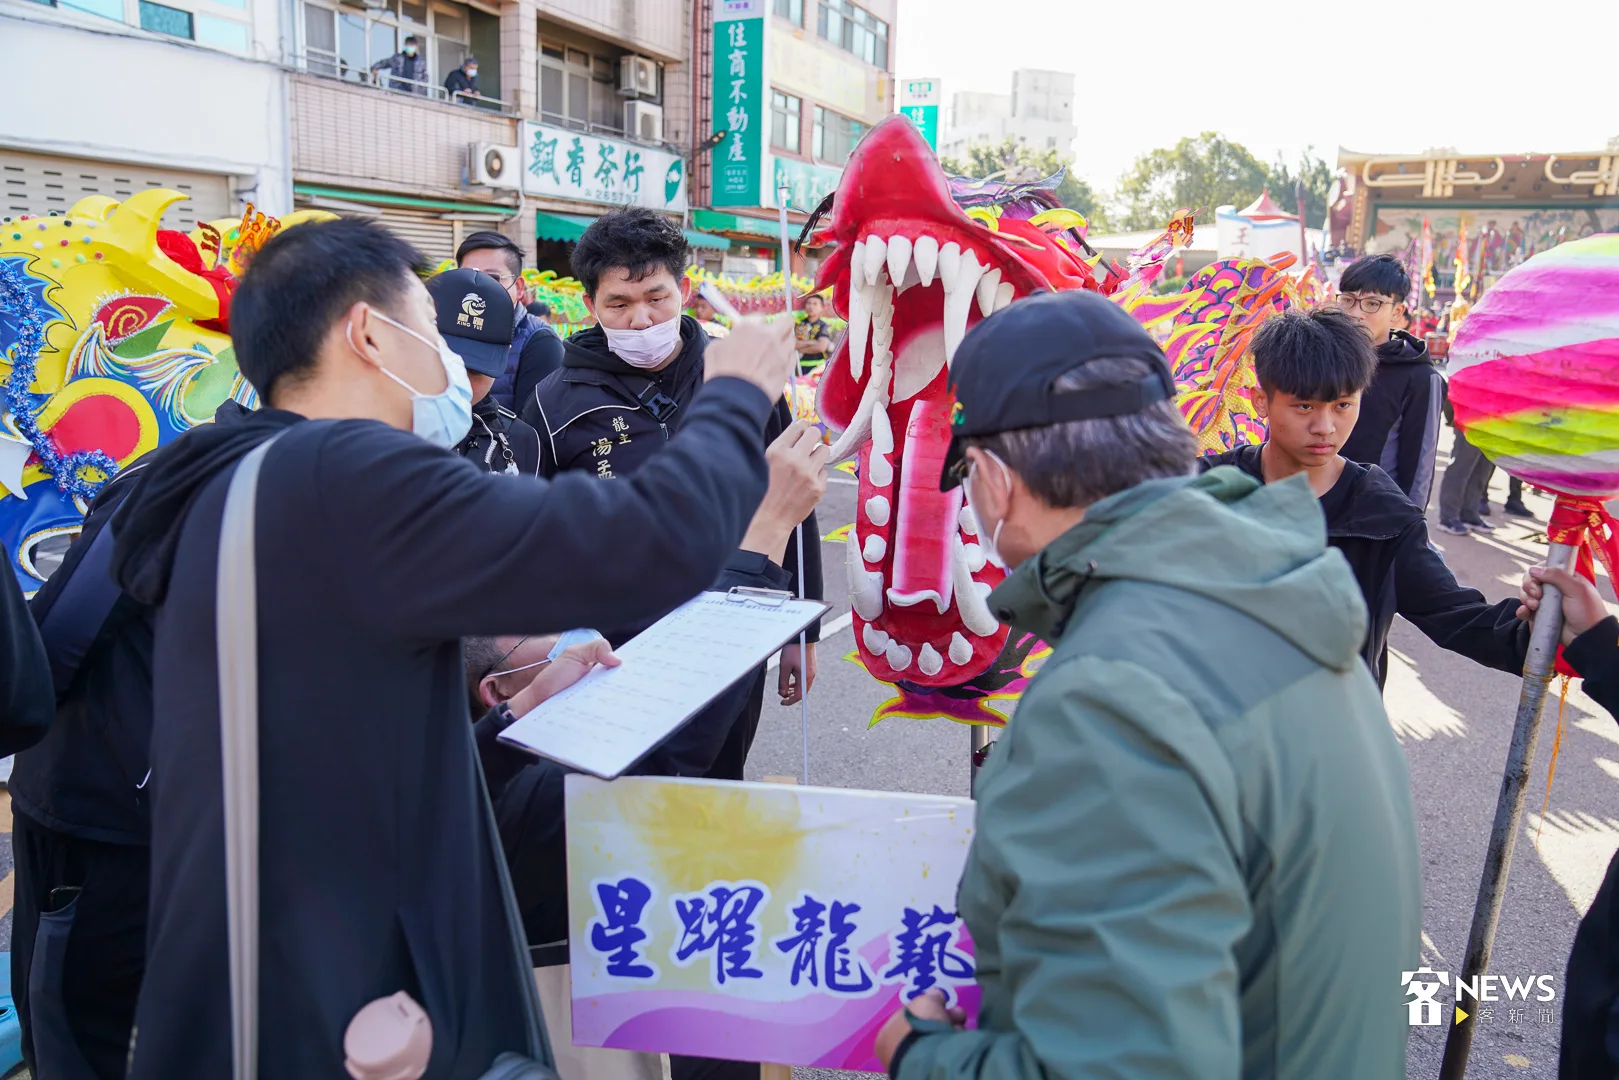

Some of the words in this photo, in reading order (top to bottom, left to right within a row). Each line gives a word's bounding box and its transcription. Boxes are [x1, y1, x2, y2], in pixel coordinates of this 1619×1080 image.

[727, 22, 749, 161] 住商不動產
[528, 130, 645, 193] 飄香茶行
[591, 877, 975, 1002] 星躍龍藝
